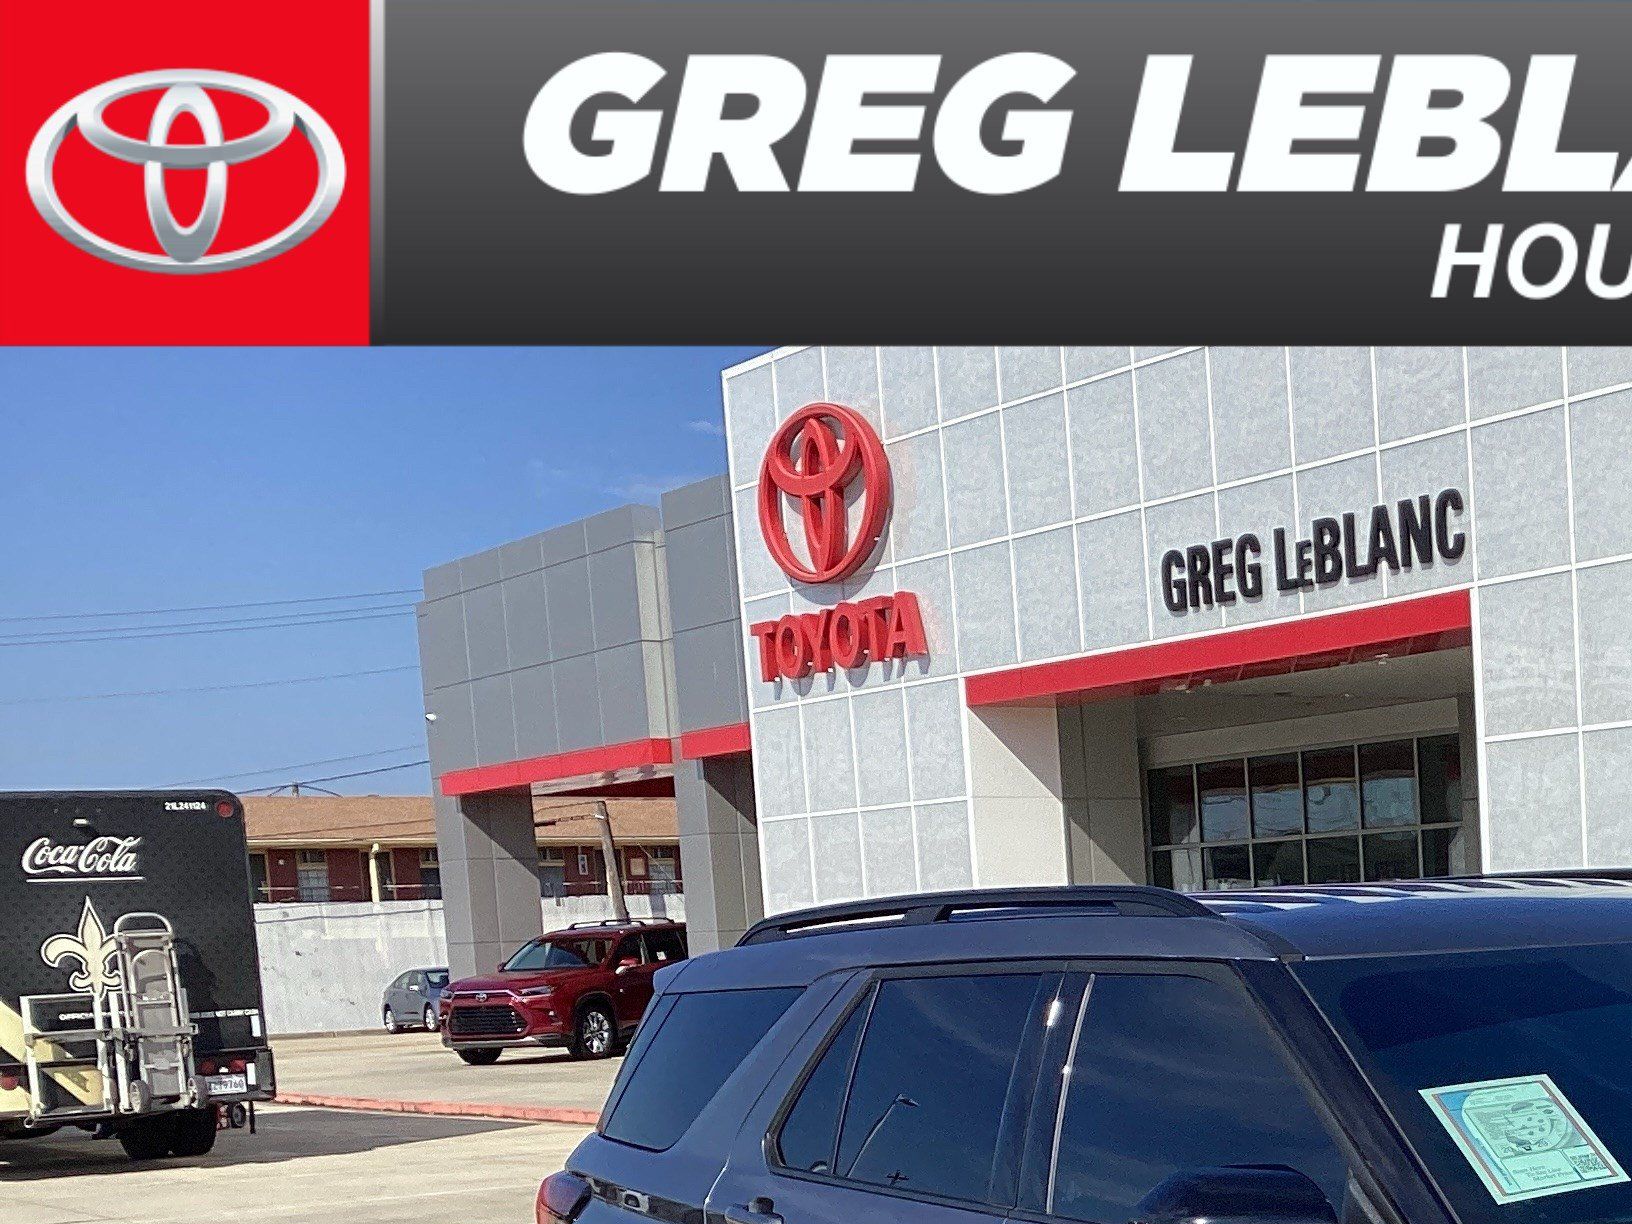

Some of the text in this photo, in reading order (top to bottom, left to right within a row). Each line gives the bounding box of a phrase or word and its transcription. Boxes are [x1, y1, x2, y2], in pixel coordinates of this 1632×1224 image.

[1161, 533, 1264, 612] GREG
[750, 591, 930, 683] TOYOTA
[21, 836, 142, 874] Coca-Cola
